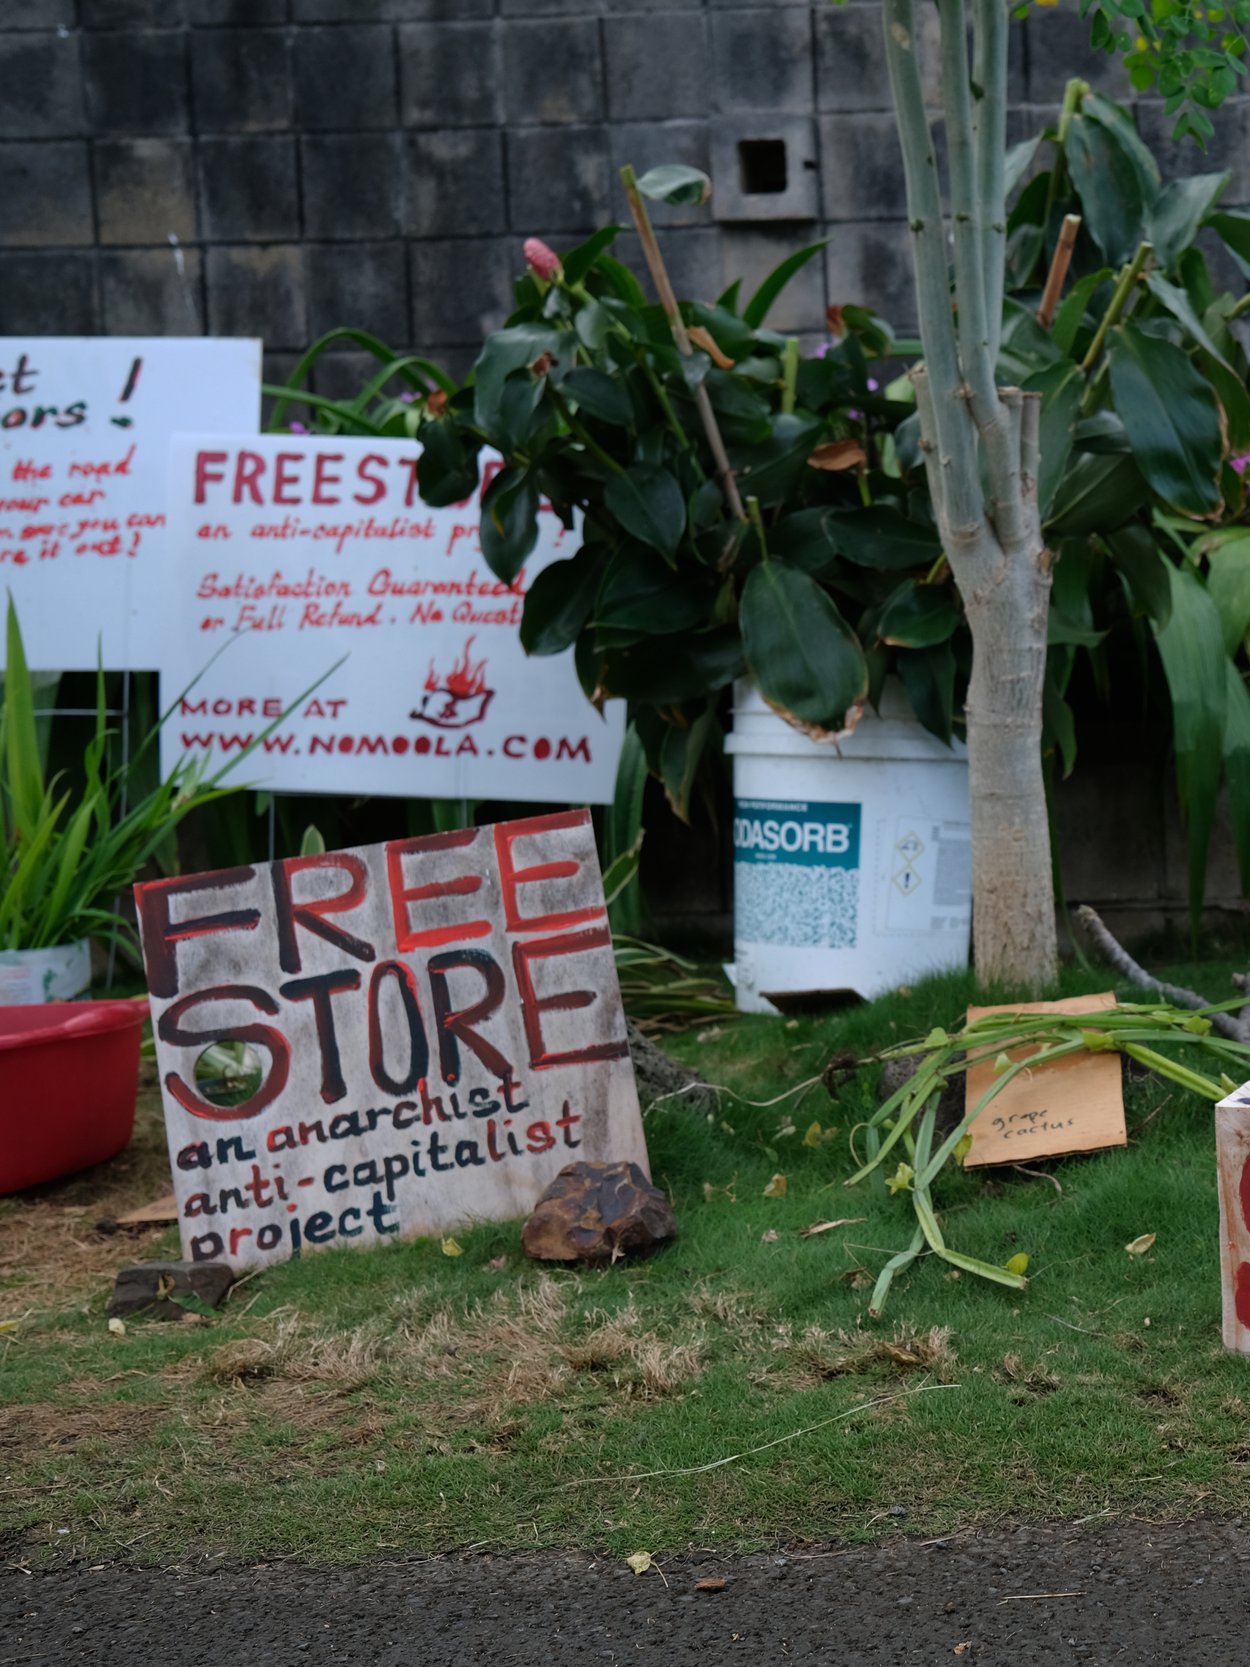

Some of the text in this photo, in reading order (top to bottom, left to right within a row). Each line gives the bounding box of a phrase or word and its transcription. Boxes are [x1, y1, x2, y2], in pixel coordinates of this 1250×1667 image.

[68, 443, 137, 482] road
[194, 450, 554, 512] FREEST
[59, 489, 105, 507] car
[127, 512, 167, 530] can
[197, 523, 231, 540] an
[251, 514, 435, 555] anti-capitalist
[39, 538, 60, 561] it
[196, 567, 351, 599] Satisfaction
[200, 616, 225, 632] or
[232, 604, 286, 632] Full
[409, 601, 443, 624] No
[452, 600, 522, 625] Quest
[180, 697, 347, 719] MORE AT
[181, 732, 592, 764] WWW.NOMOOLA.COM
[134, 809, 606, 997] FREE
[159, 925, 630, 1121] STORE
[177, 1072, 530, 1170] an anarchist
[992, 1110, 1048, 1130] grape
[1004, 1118, 1074, 1139] cactus
[184, 1101, 582, 1217] anti-capitalist
[191, 1191, 400, 1262] project
